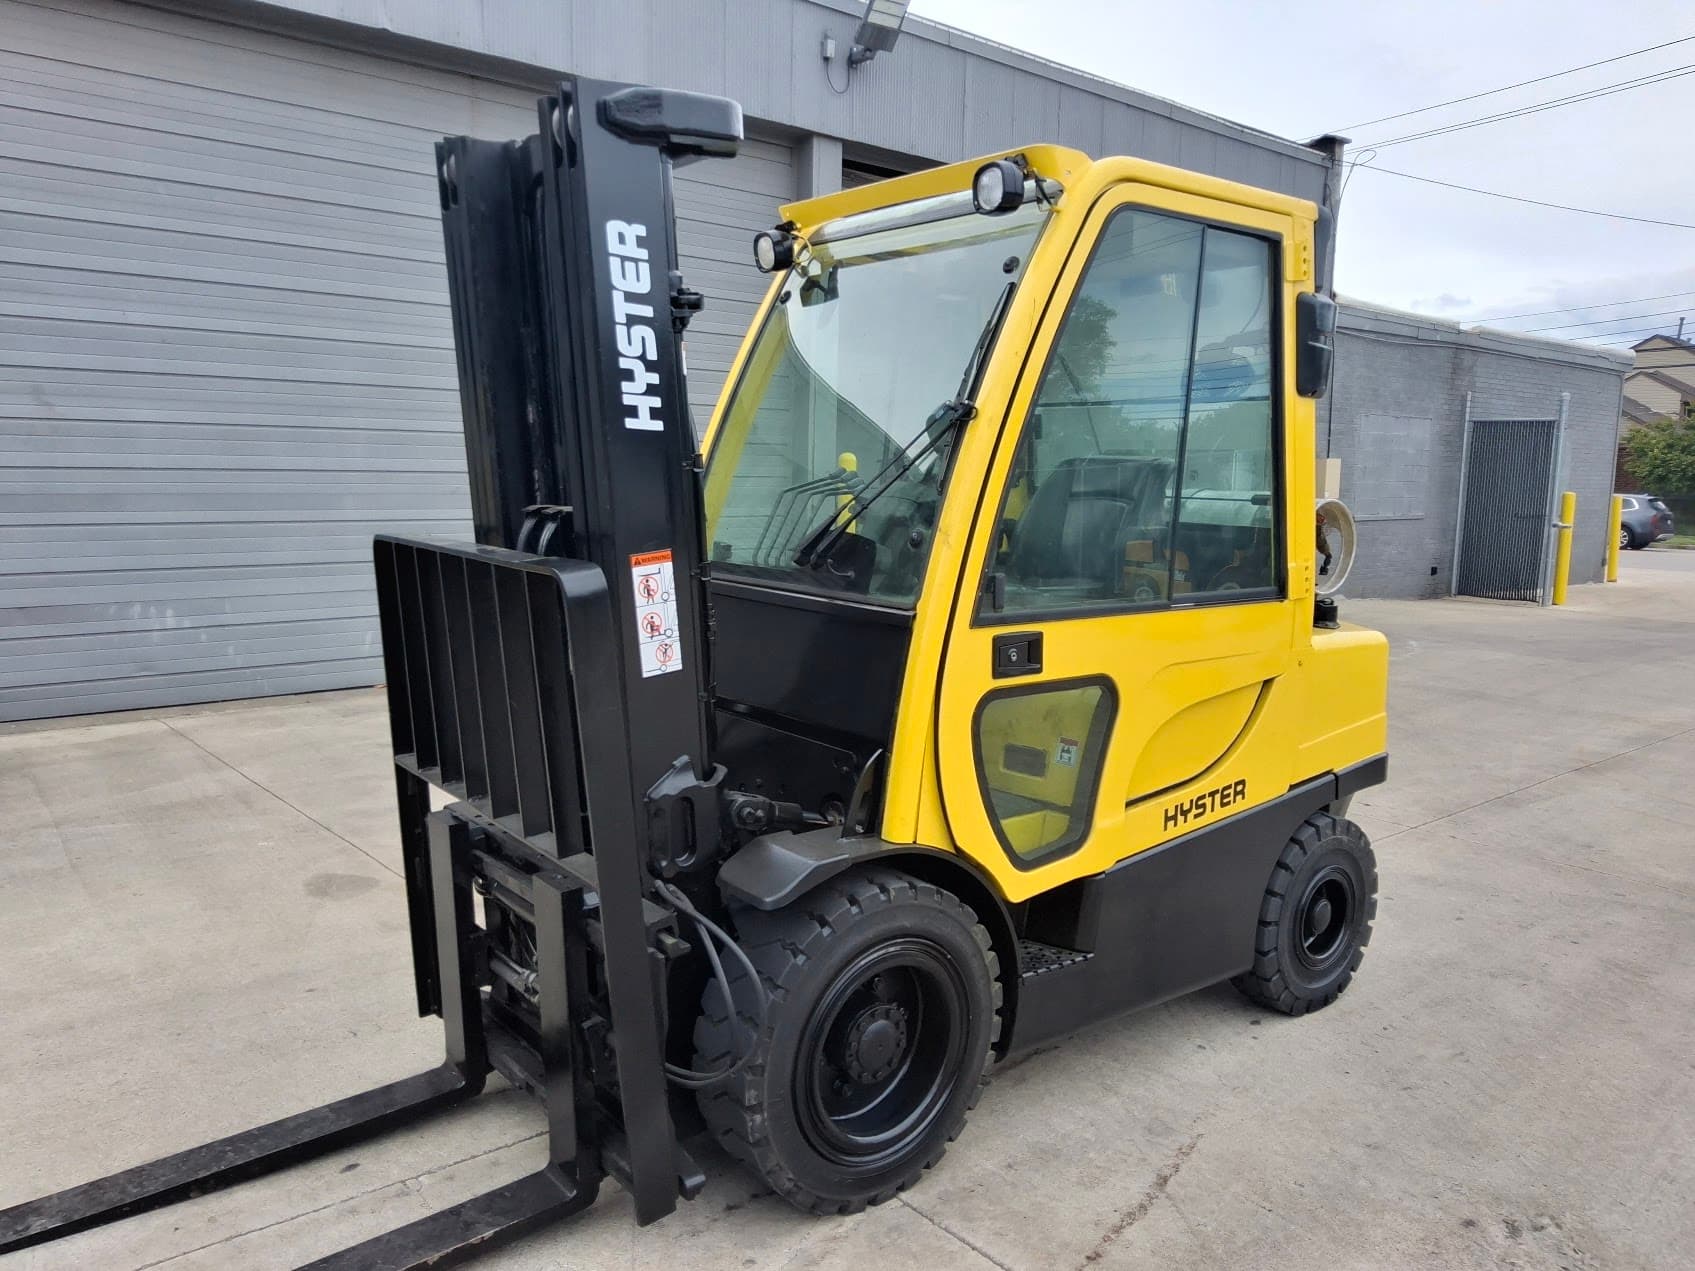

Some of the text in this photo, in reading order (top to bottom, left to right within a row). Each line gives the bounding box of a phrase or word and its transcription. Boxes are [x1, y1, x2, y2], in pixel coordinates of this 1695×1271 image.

[606, 219, 665, 432] HYSTER
[641, 553, 671, 563] WARNING
[1163, 778, 1247, 832] HYSTER
